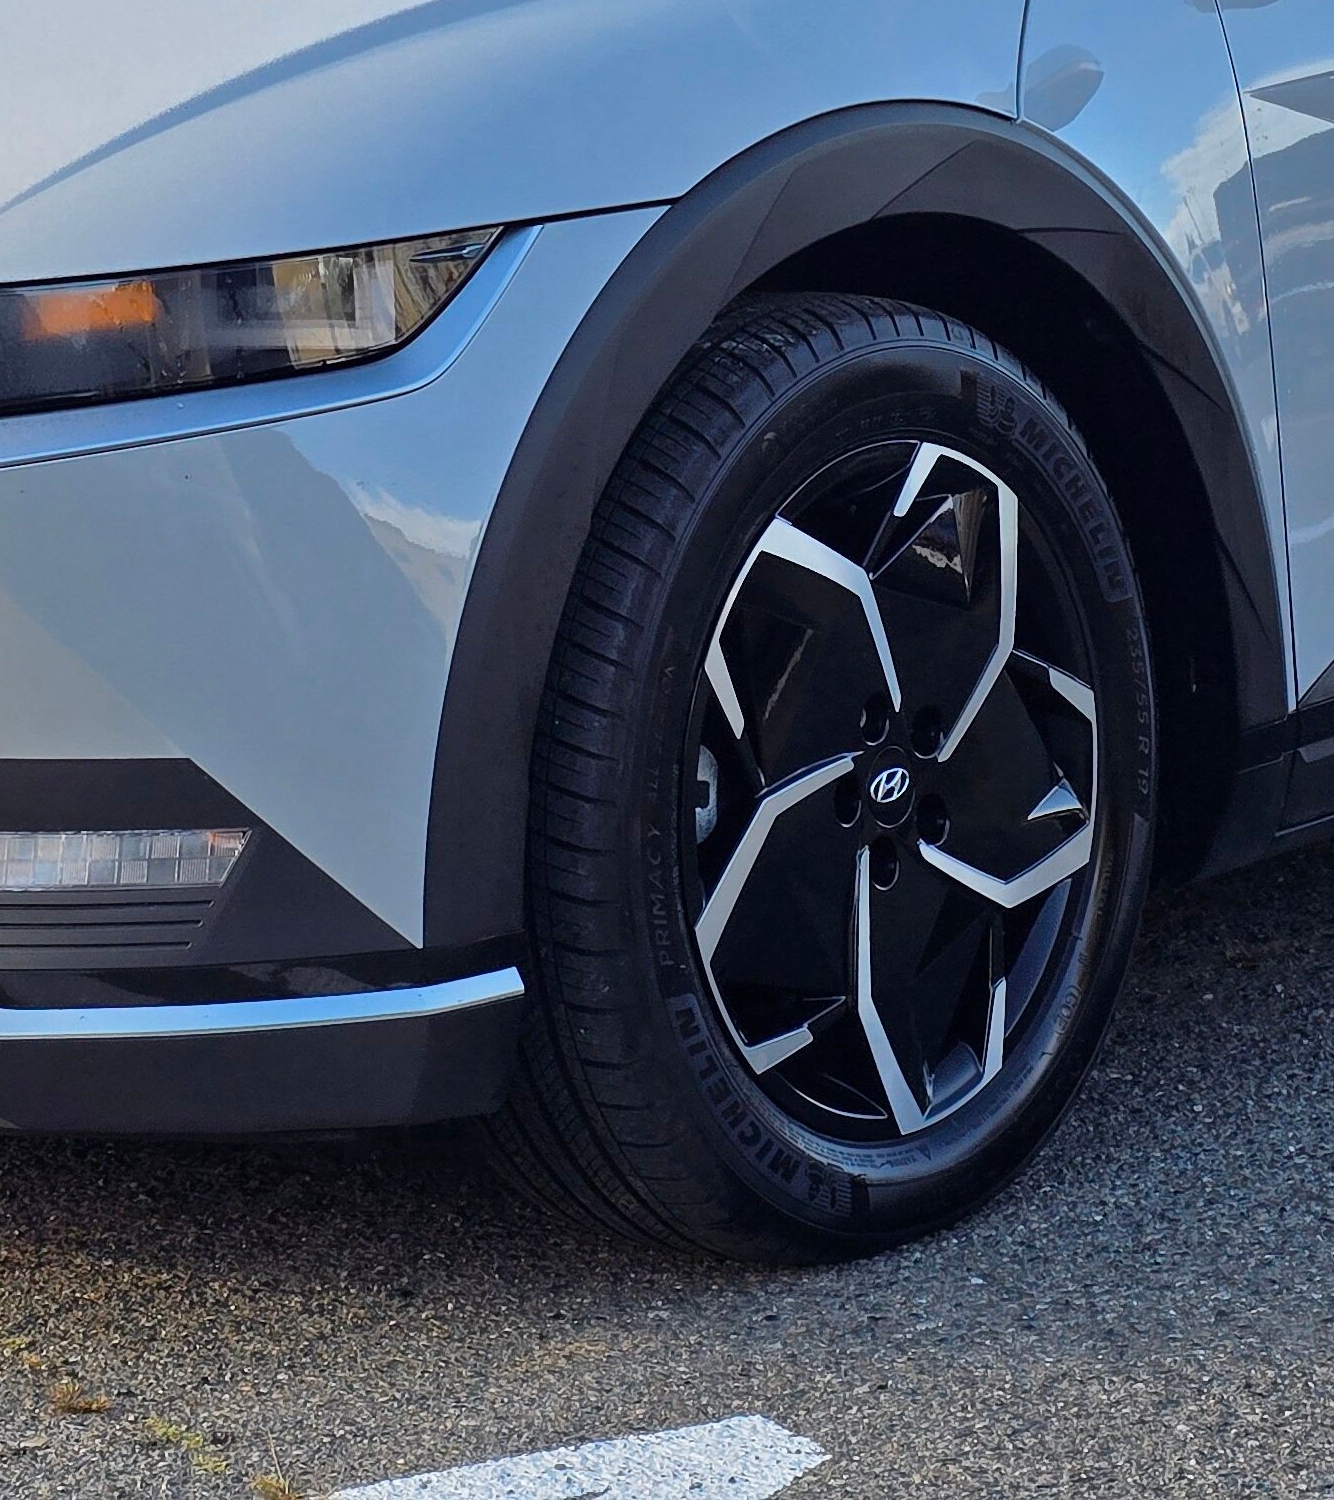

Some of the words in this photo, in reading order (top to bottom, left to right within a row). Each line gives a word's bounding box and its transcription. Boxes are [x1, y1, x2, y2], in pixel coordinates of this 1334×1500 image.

[1019, 417, 1124, 590] MICHELIN
[646, 824, 674, 967] PRIMACY
[674, 1007, 801, 1183] MICHELIN
